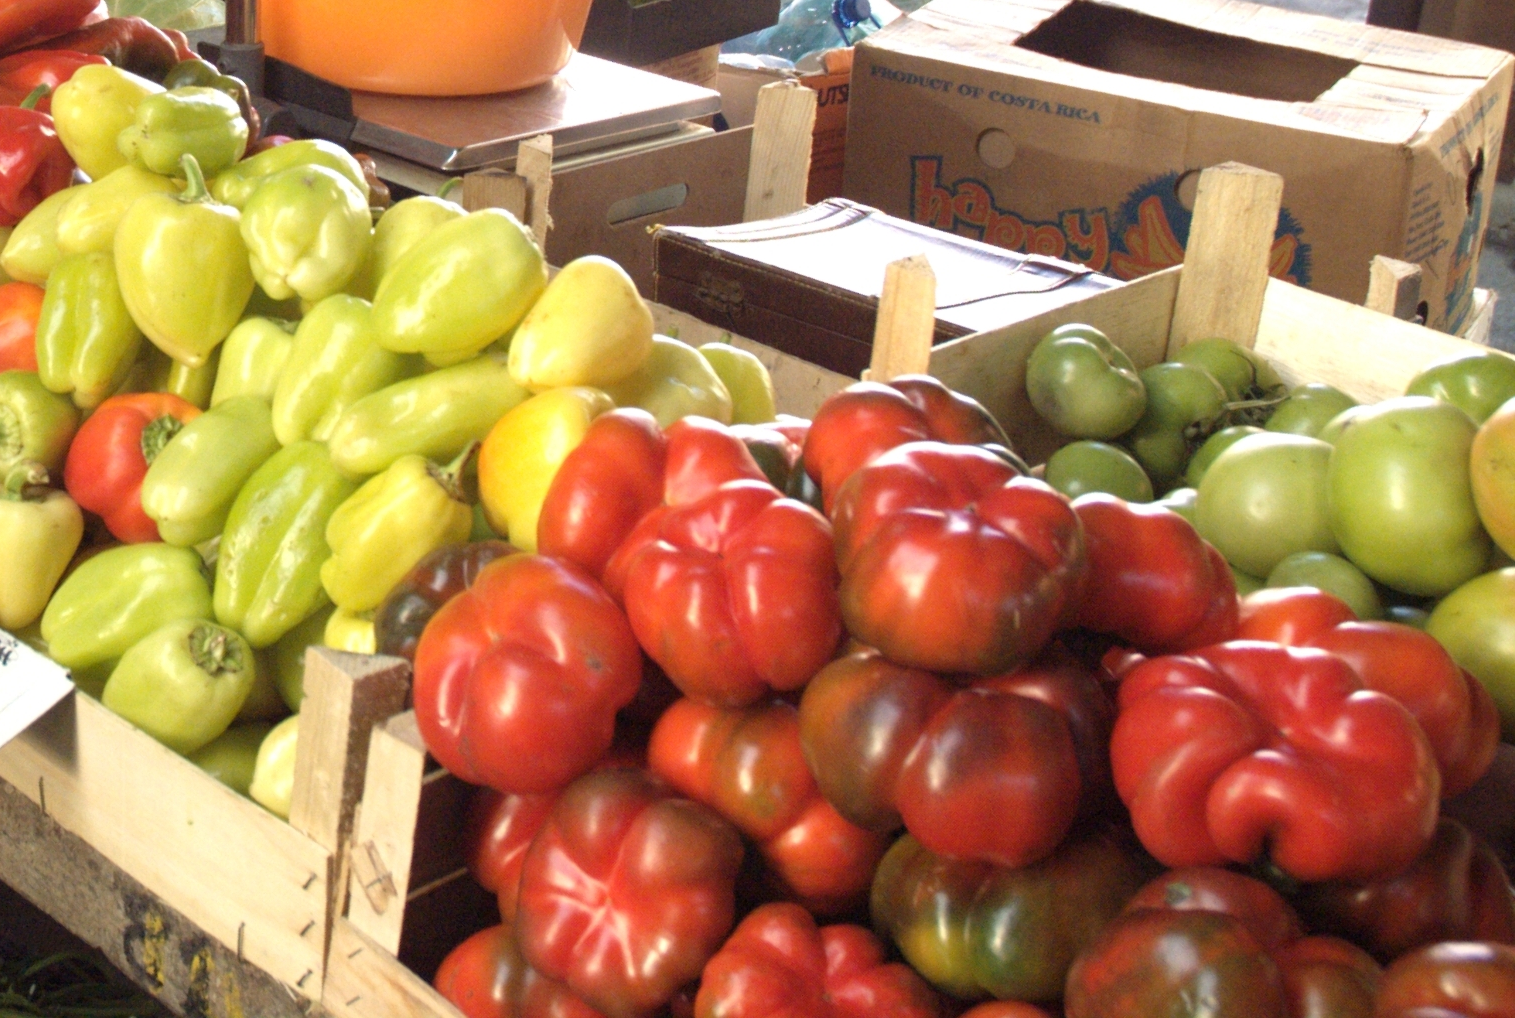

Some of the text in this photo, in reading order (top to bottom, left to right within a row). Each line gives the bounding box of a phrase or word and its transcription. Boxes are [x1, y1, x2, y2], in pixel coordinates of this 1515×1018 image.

[870, 64, 1101, 124] PRODUCT OF COSTA RICA
[909, 155, 1110, 274] happy
